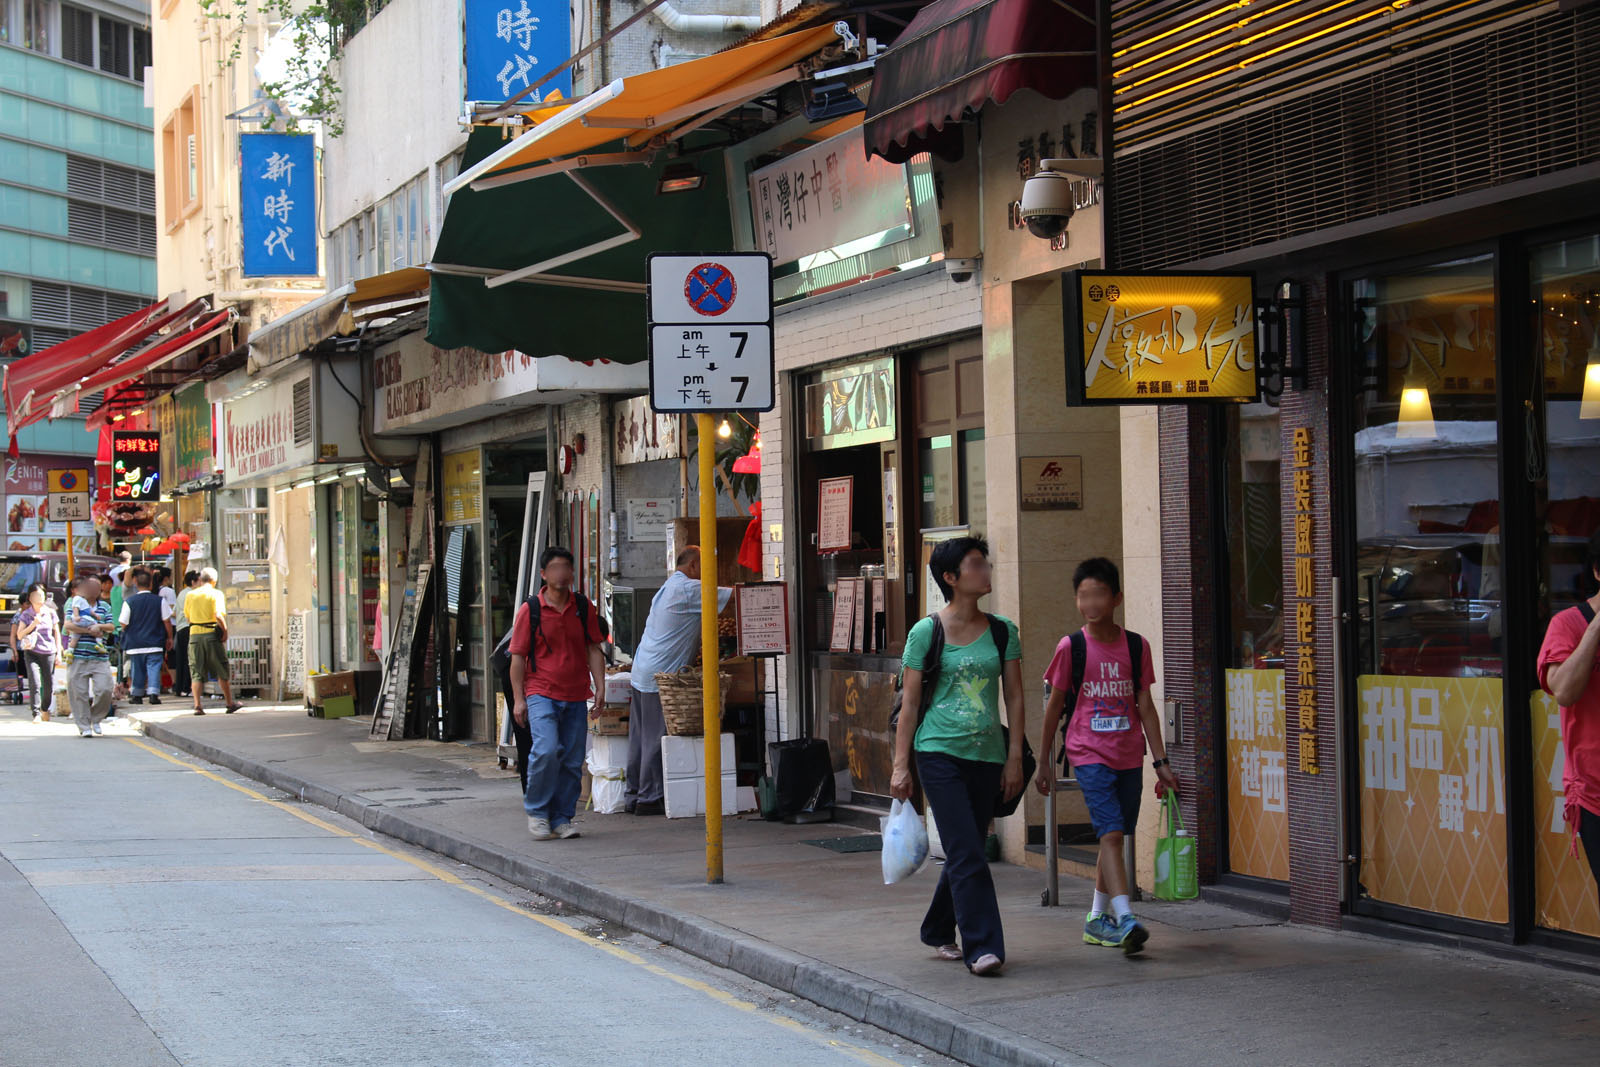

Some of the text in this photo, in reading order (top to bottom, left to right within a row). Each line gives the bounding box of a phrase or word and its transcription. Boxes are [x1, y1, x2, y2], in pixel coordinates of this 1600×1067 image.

[496, 0, 542, 103] 時代
[261, 151, 296, 262] 新時代
[1088, 284, 1120, 302] 金裝
[677, 344, 710, 359] 上午
[682, 330, 748, 359] am 7
[677, 389, 711, 404] 下午
[683, 375, 749, 403] pm 7
[60, 496, 78, 504] End
[56, 507, 82, 518] 終止
[1100, 662, 1119, 679] I'M
[1082, 680, 1134, 699] SMARTER
[1093, 719, 1113, 729] THAN
[1362, 686, 1443, 792] 甜品
